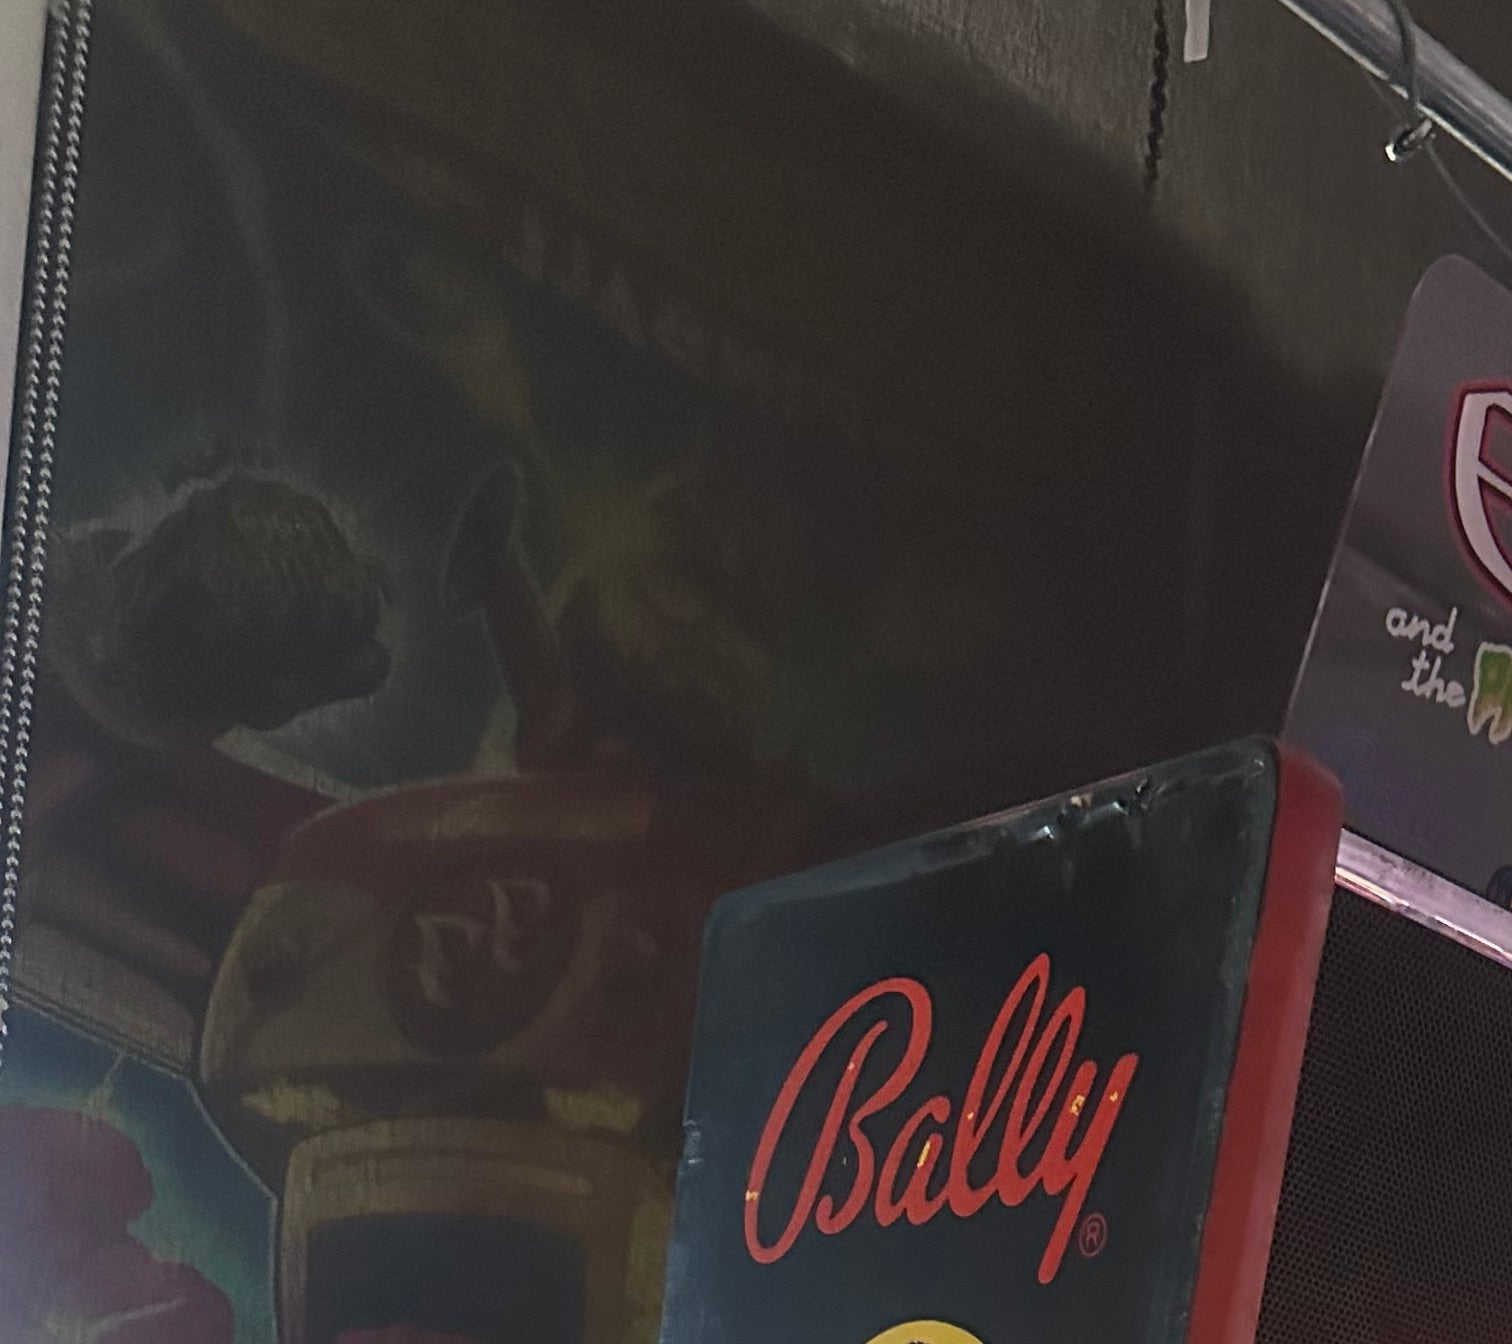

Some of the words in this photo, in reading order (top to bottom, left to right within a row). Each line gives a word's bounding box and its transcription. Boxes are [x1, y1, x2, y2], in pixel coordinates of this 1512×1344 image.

[1386, 607, 1457, 652] and
[1401, 651, 1466, 708] the
[744, 952, 1139, 1284] Bally
